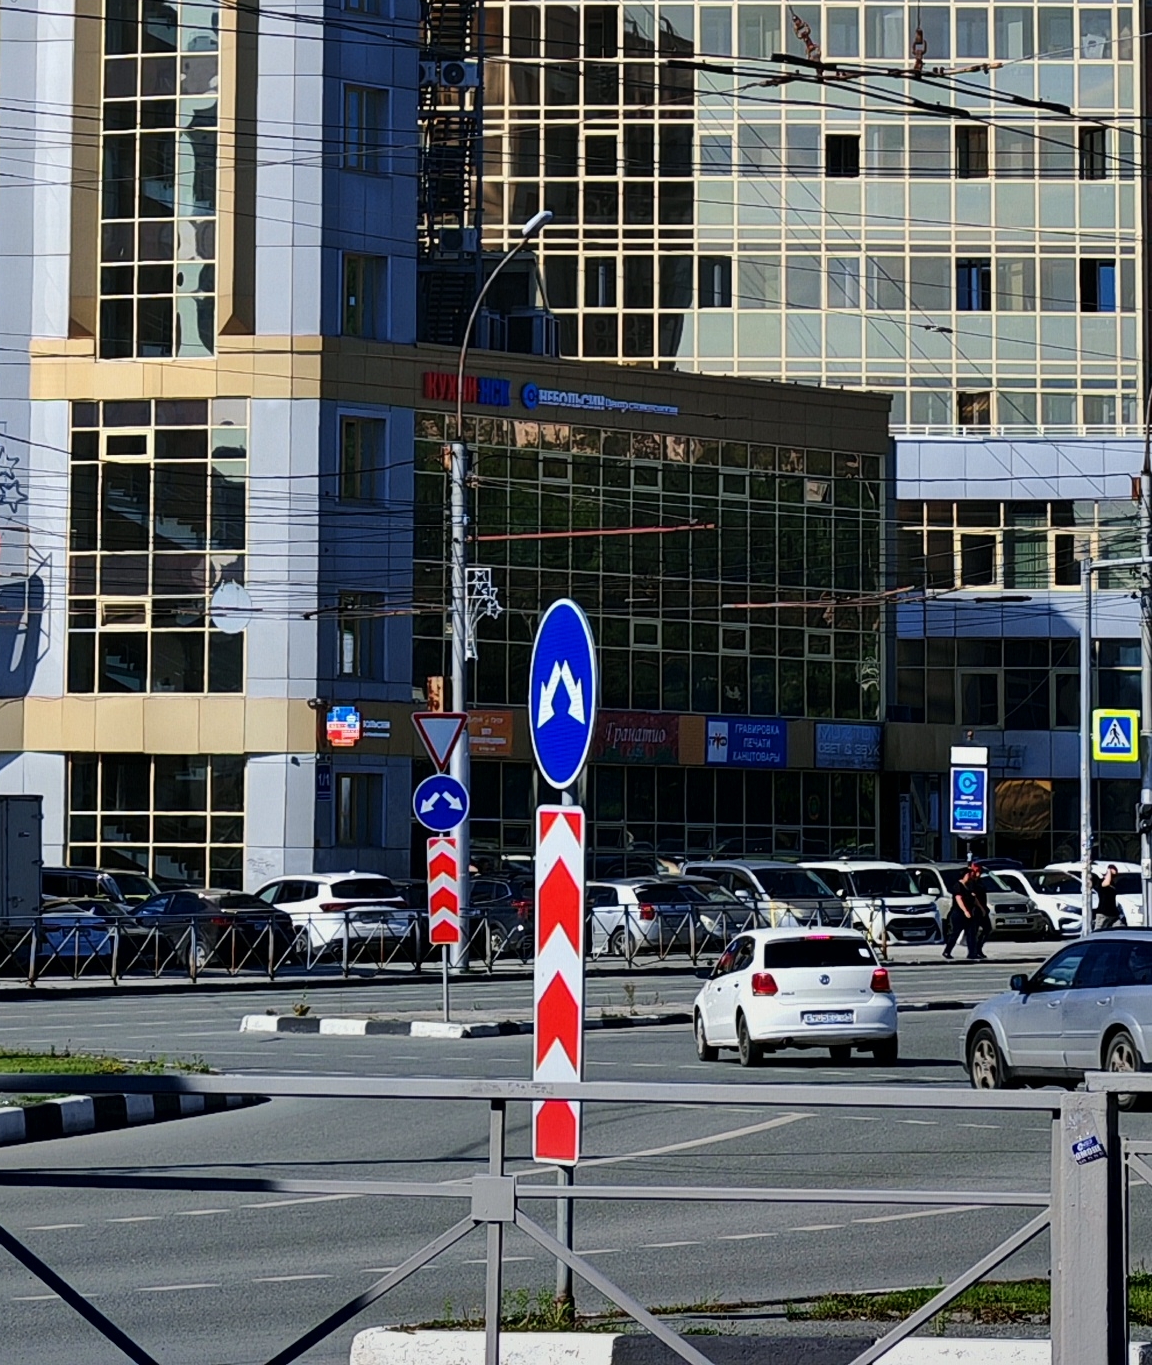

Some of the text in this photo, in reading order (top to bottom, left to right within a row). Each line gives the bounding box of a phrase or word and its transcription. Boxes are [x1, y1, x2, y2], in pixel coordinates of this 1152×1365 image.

[735, 723, 780, 735] ГРАВИРОВКА
[743, 737, 771, 748] ПЕЧАТИ
[818, 742, 841, 754] СВЕТ
